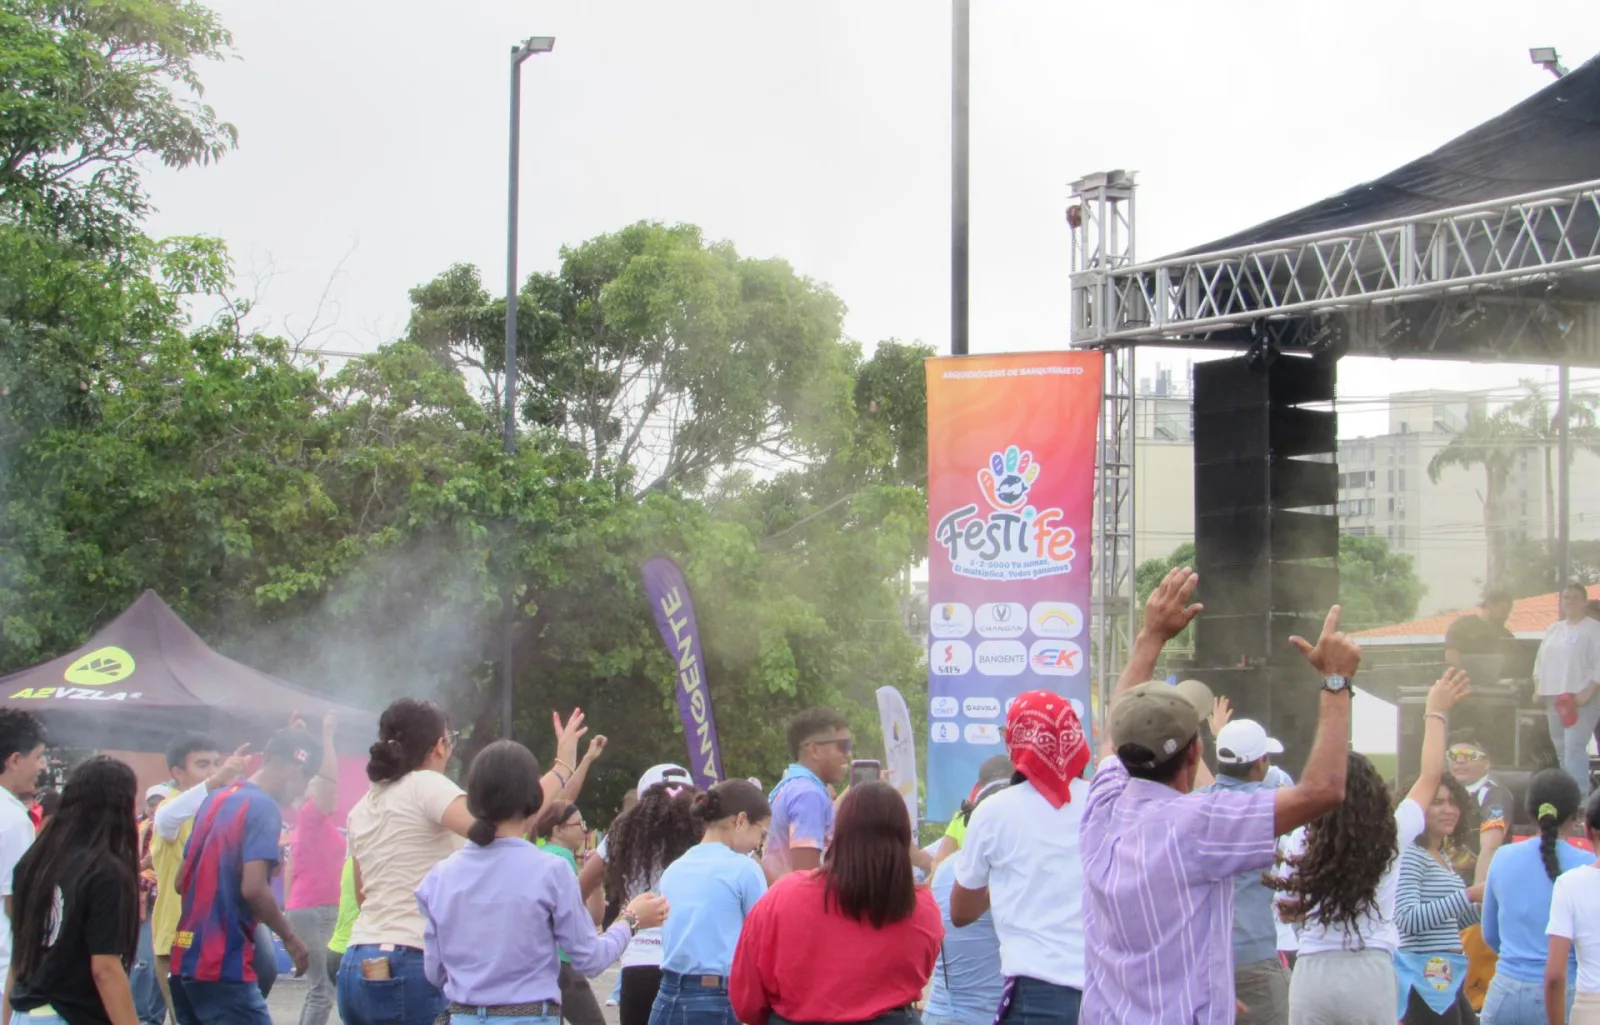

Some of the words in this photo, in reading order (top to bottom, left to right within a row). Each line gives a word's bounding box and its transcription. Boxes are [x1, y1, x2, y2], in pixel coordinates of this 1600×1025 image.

[1007, 368, 1018, 376] DE
[1019, 366, 1084, 376] BARQUISIMETO
[1032, 564, 1069, 577] ganamos
[979, 625, 1023, 633] CHANGAN
[661, 586, 719, 791] ANGENTE
